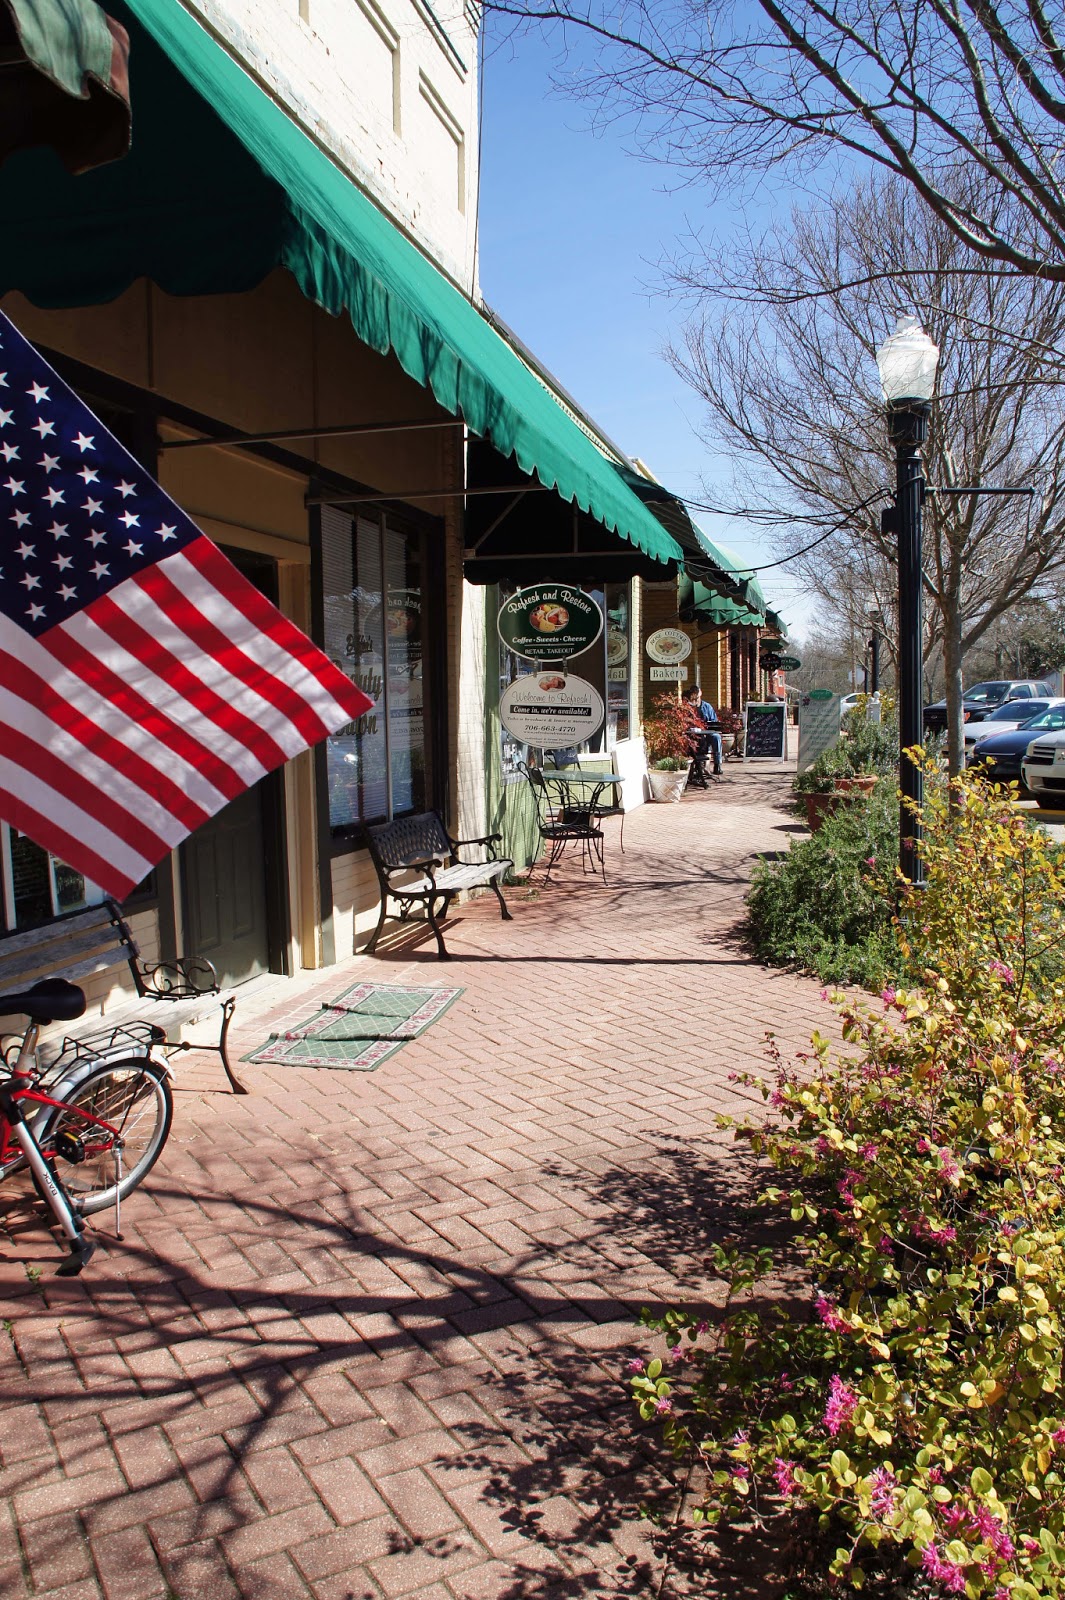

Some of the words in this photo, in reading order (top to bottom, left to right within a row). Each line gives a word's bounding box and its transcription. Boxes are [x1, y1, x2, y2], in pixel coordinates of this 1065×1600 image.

[507, 590, 541, 614] Refresh
[542, 589, 558, 601] and
[560, 589, 592, 614] Restore
[512, 636, 533, 644] Coffee
[562, 635, 587, 643] Cheese
[653, 668, 685, 679] Bakery
[511, 690, 546, 703] Welcome
[547, 693, 556, 703] to
[556, 692, 592, 706] Refresh!
[513, 705, 531, 713] Come
[43, 1172, 58, 1196] BACK
